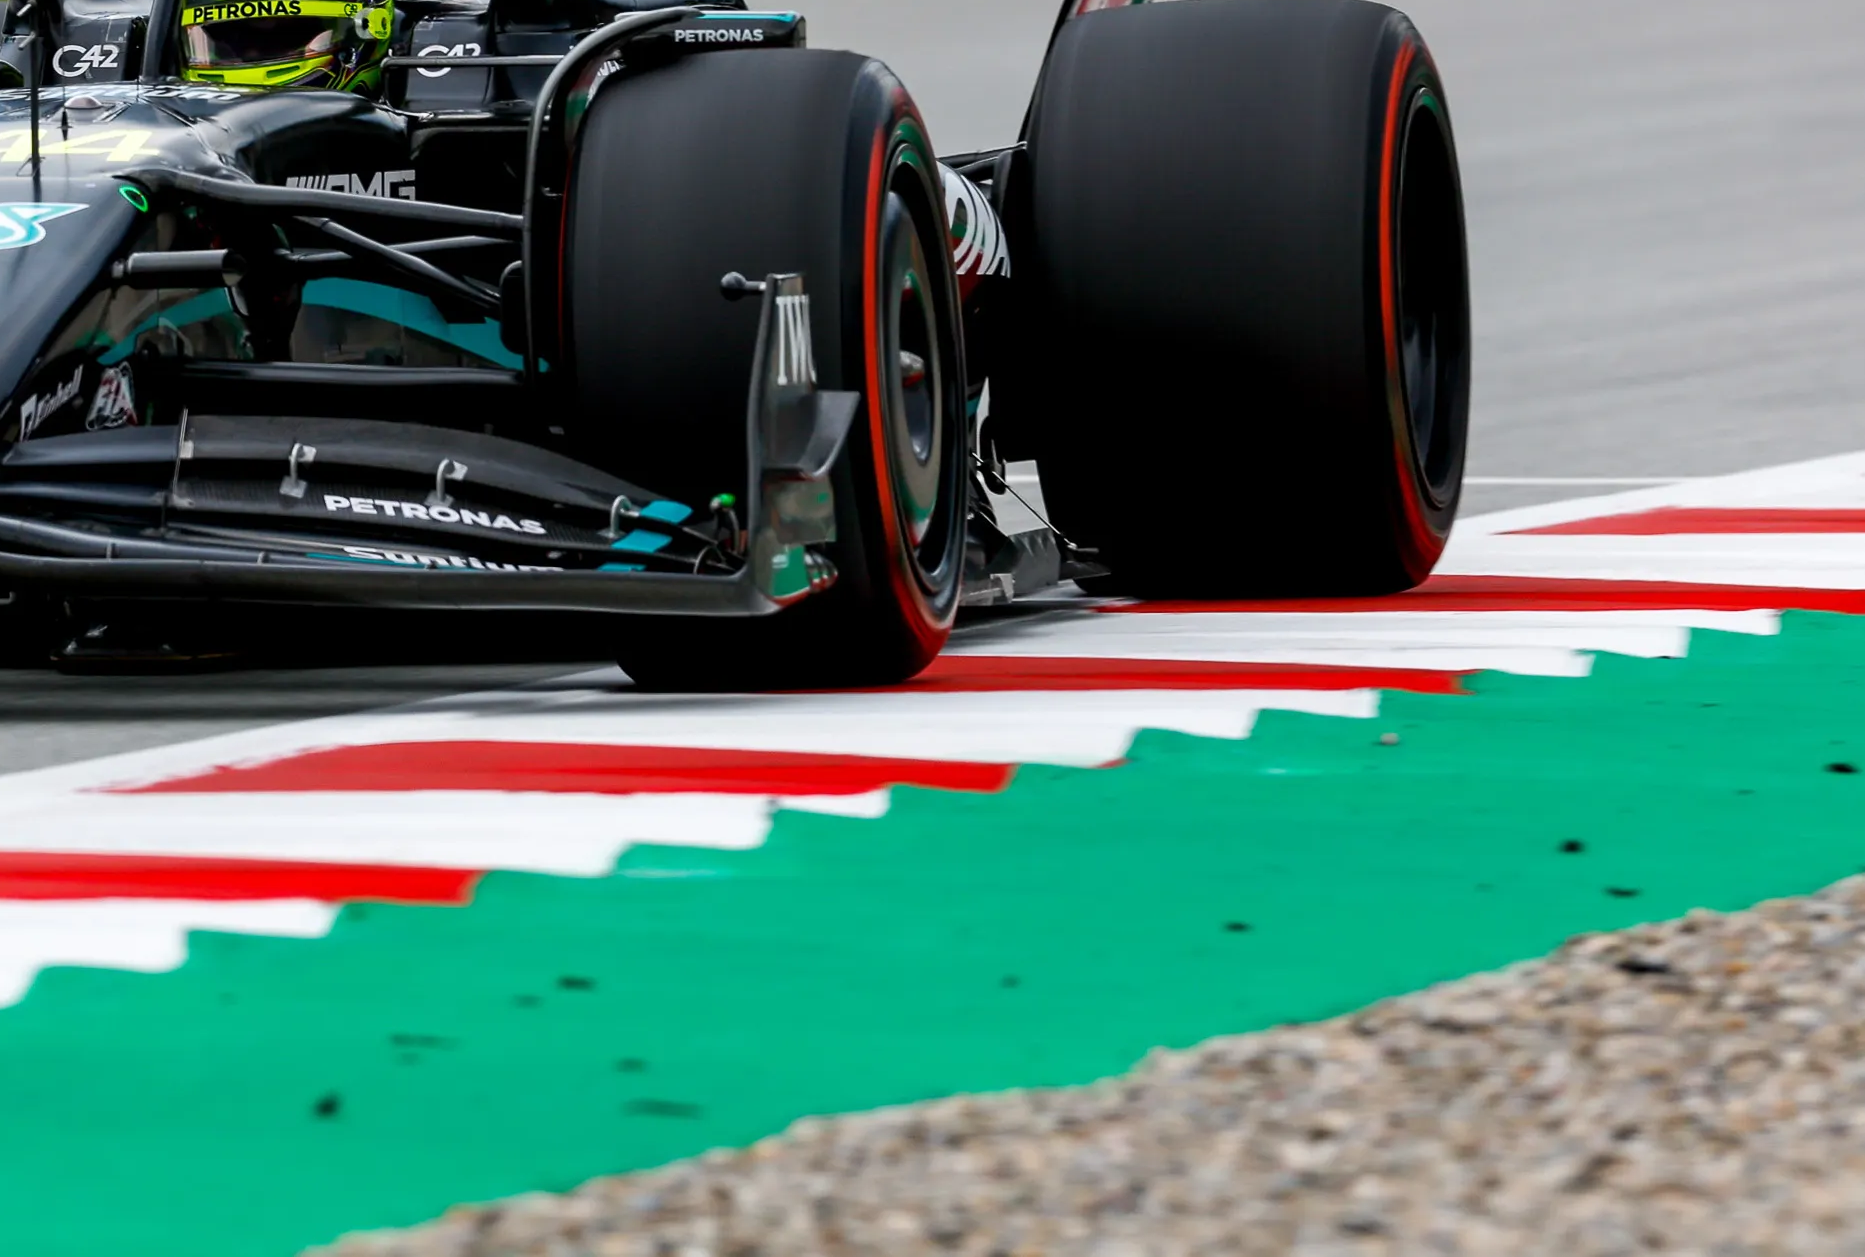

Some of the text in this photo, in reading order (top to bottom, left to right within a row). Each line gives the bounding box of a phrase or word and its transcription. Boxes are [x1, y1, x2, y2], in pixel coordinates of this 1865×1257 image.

[193, 0, 302, 23] PETRONAS
[674, 29, 764, 42] PETRONAS
[52, 44, 120, 78] G42
[323, 494, 548, 535] PETRONAS
